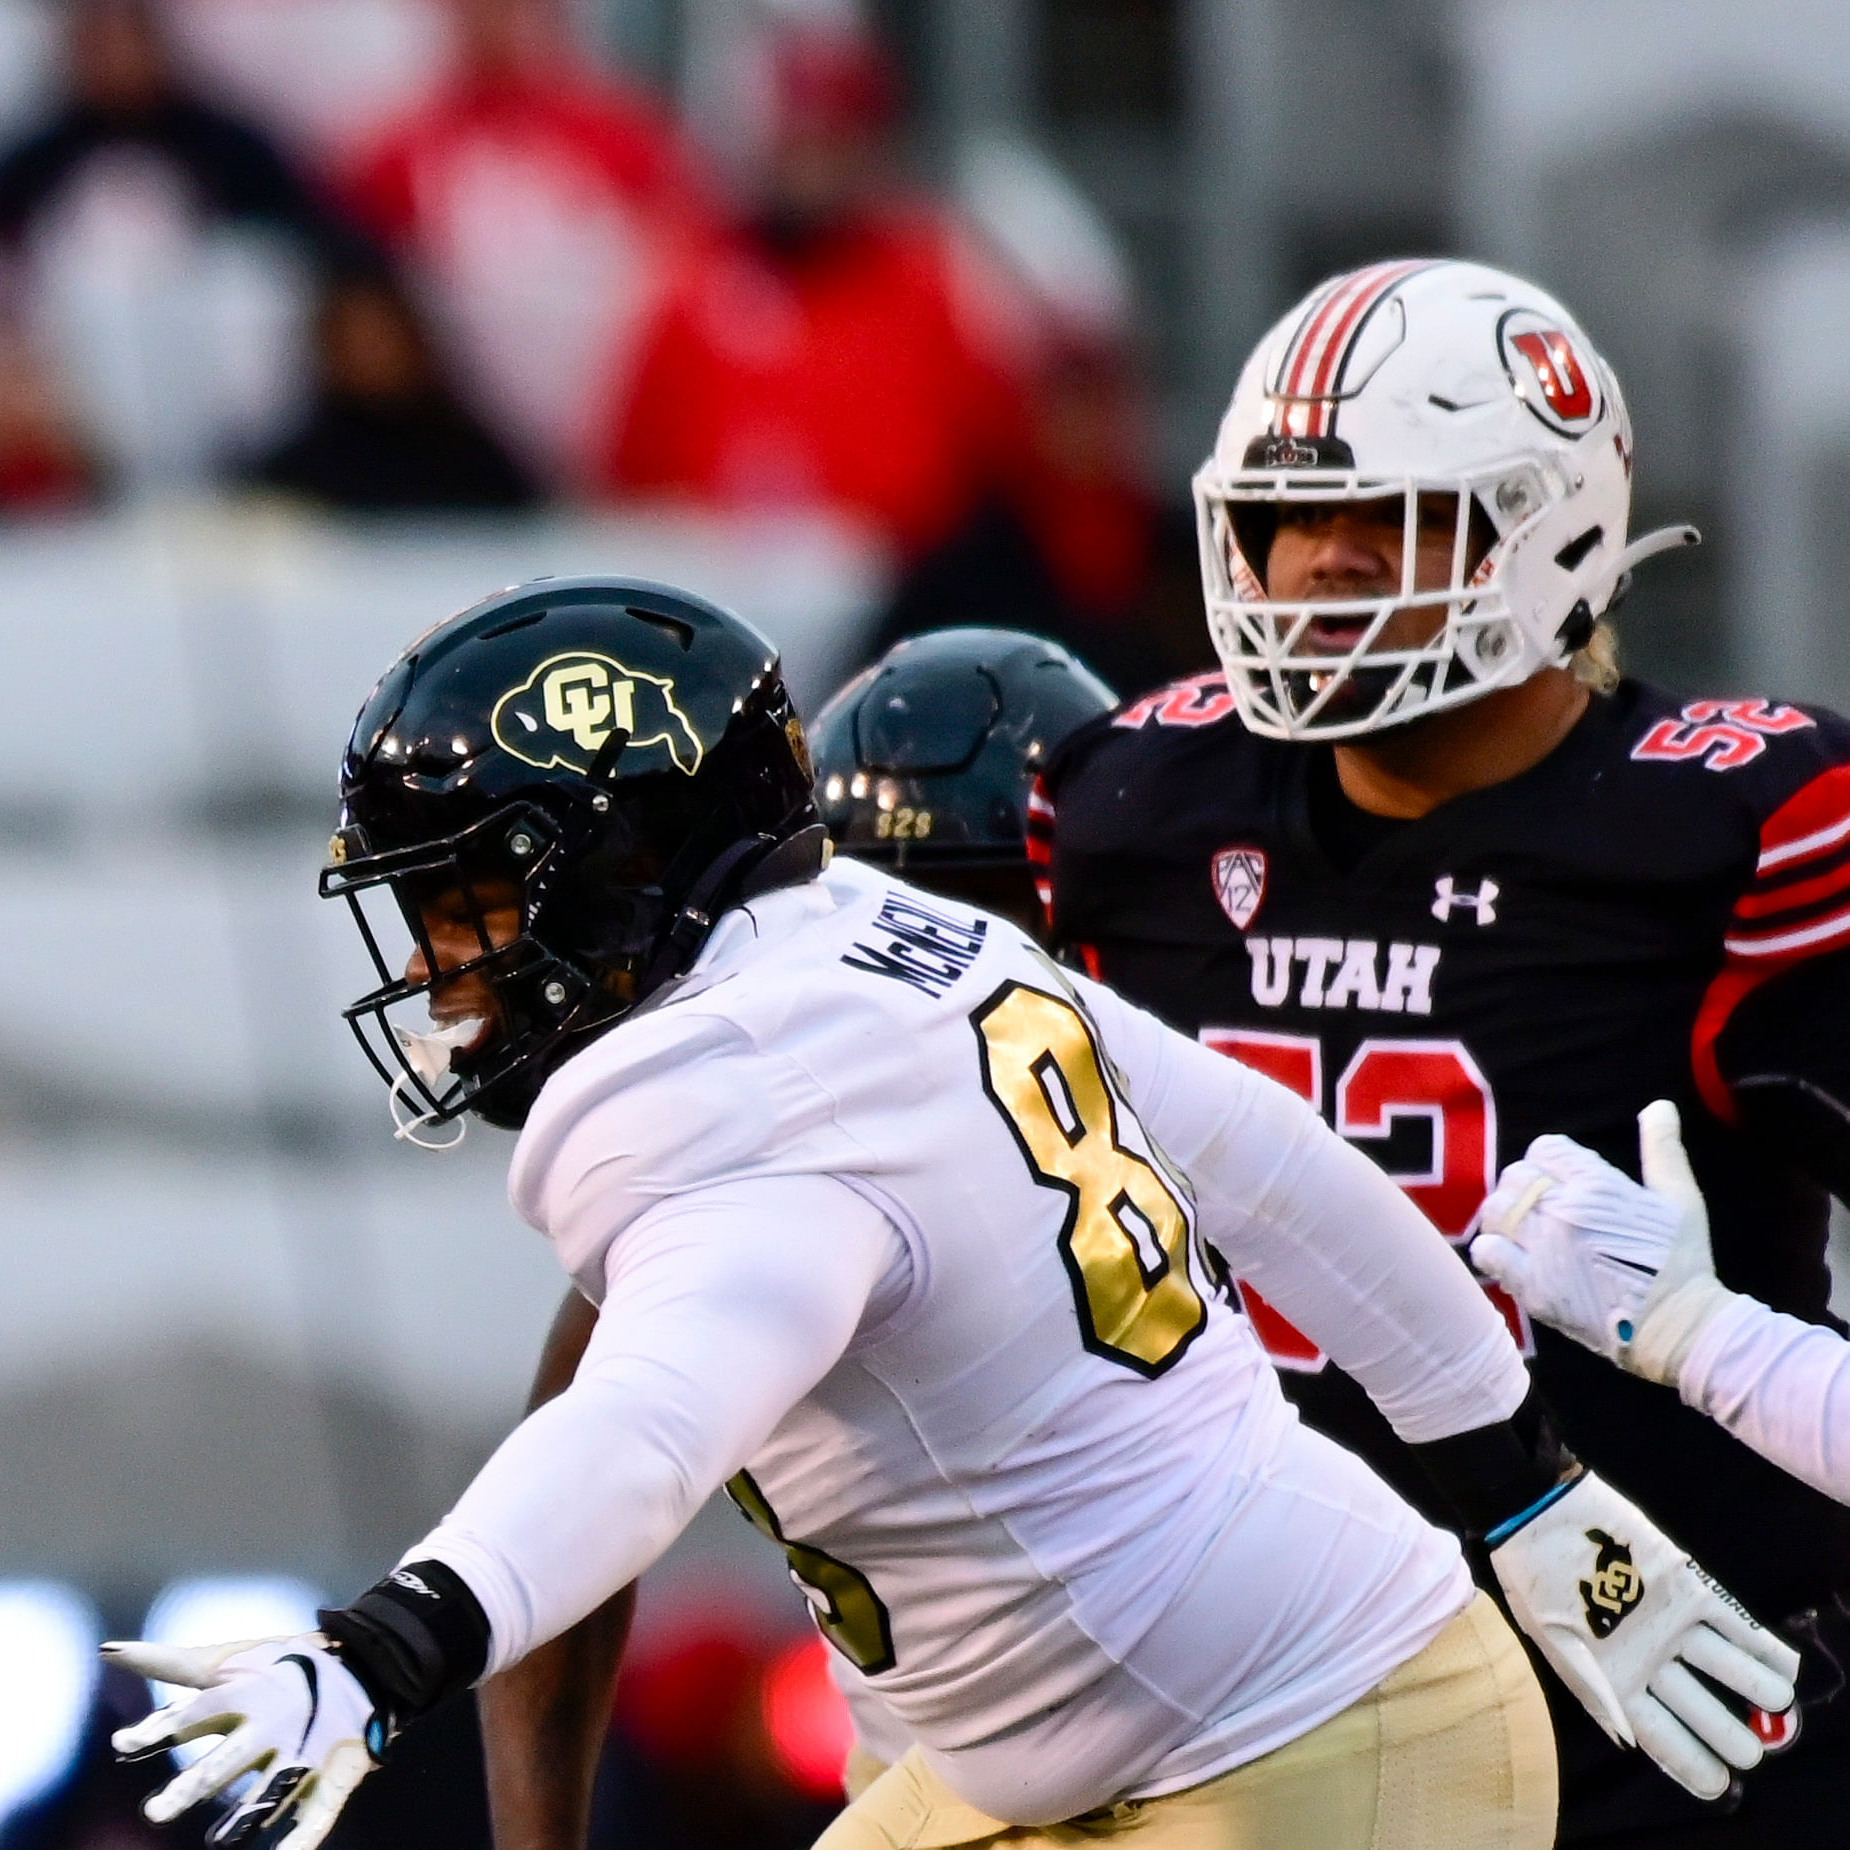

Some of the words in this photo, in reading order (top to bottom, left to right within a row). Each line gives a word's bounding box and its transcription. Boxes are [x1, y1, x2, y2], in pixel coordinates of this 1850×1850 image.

[1509, 330, 1593, 422] U
[543, 663, 635, 751] CU
[1630, 699, 1818, 772] 52
[1245, 936, 1442, 1016] UTAH
